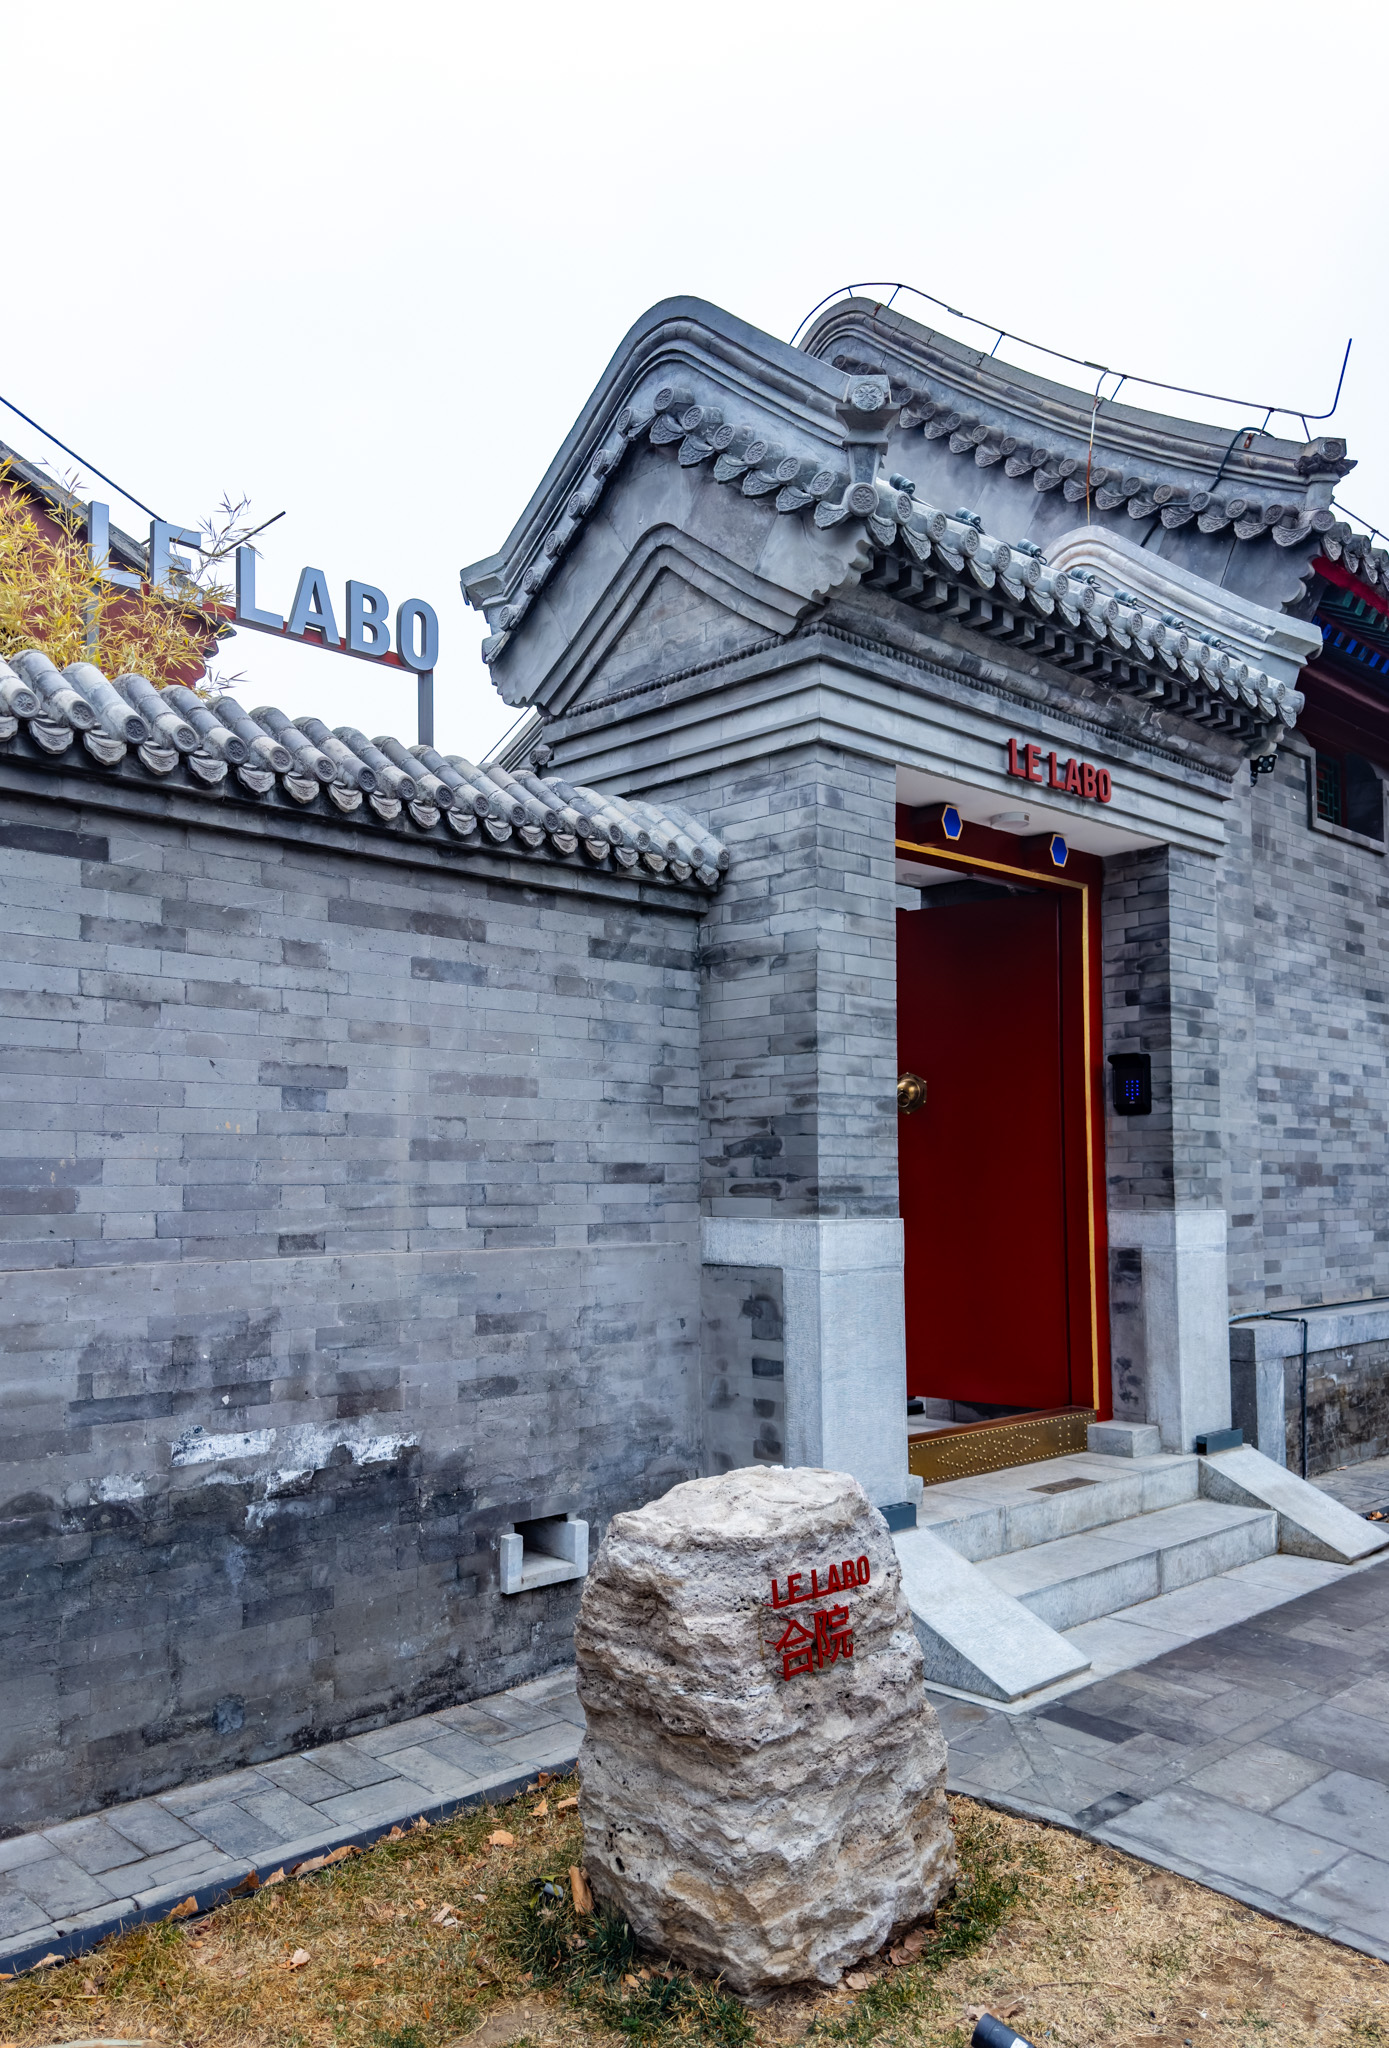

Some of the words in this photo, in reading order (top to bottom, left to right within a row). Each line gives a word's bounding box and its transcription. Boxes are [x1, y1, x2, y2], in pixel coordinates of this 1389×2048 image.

[88, 501, 203, 608] LE
[236, 546, 439, 671] LABO
[1007, 738, 1042, 783] LE
[1047, 752, 1112, 803] LABO
[771, 1573, 812, 1610] LE
[811, 1555, 870, 1599] LABO
[774, 1604, 854, 1682] 合院
